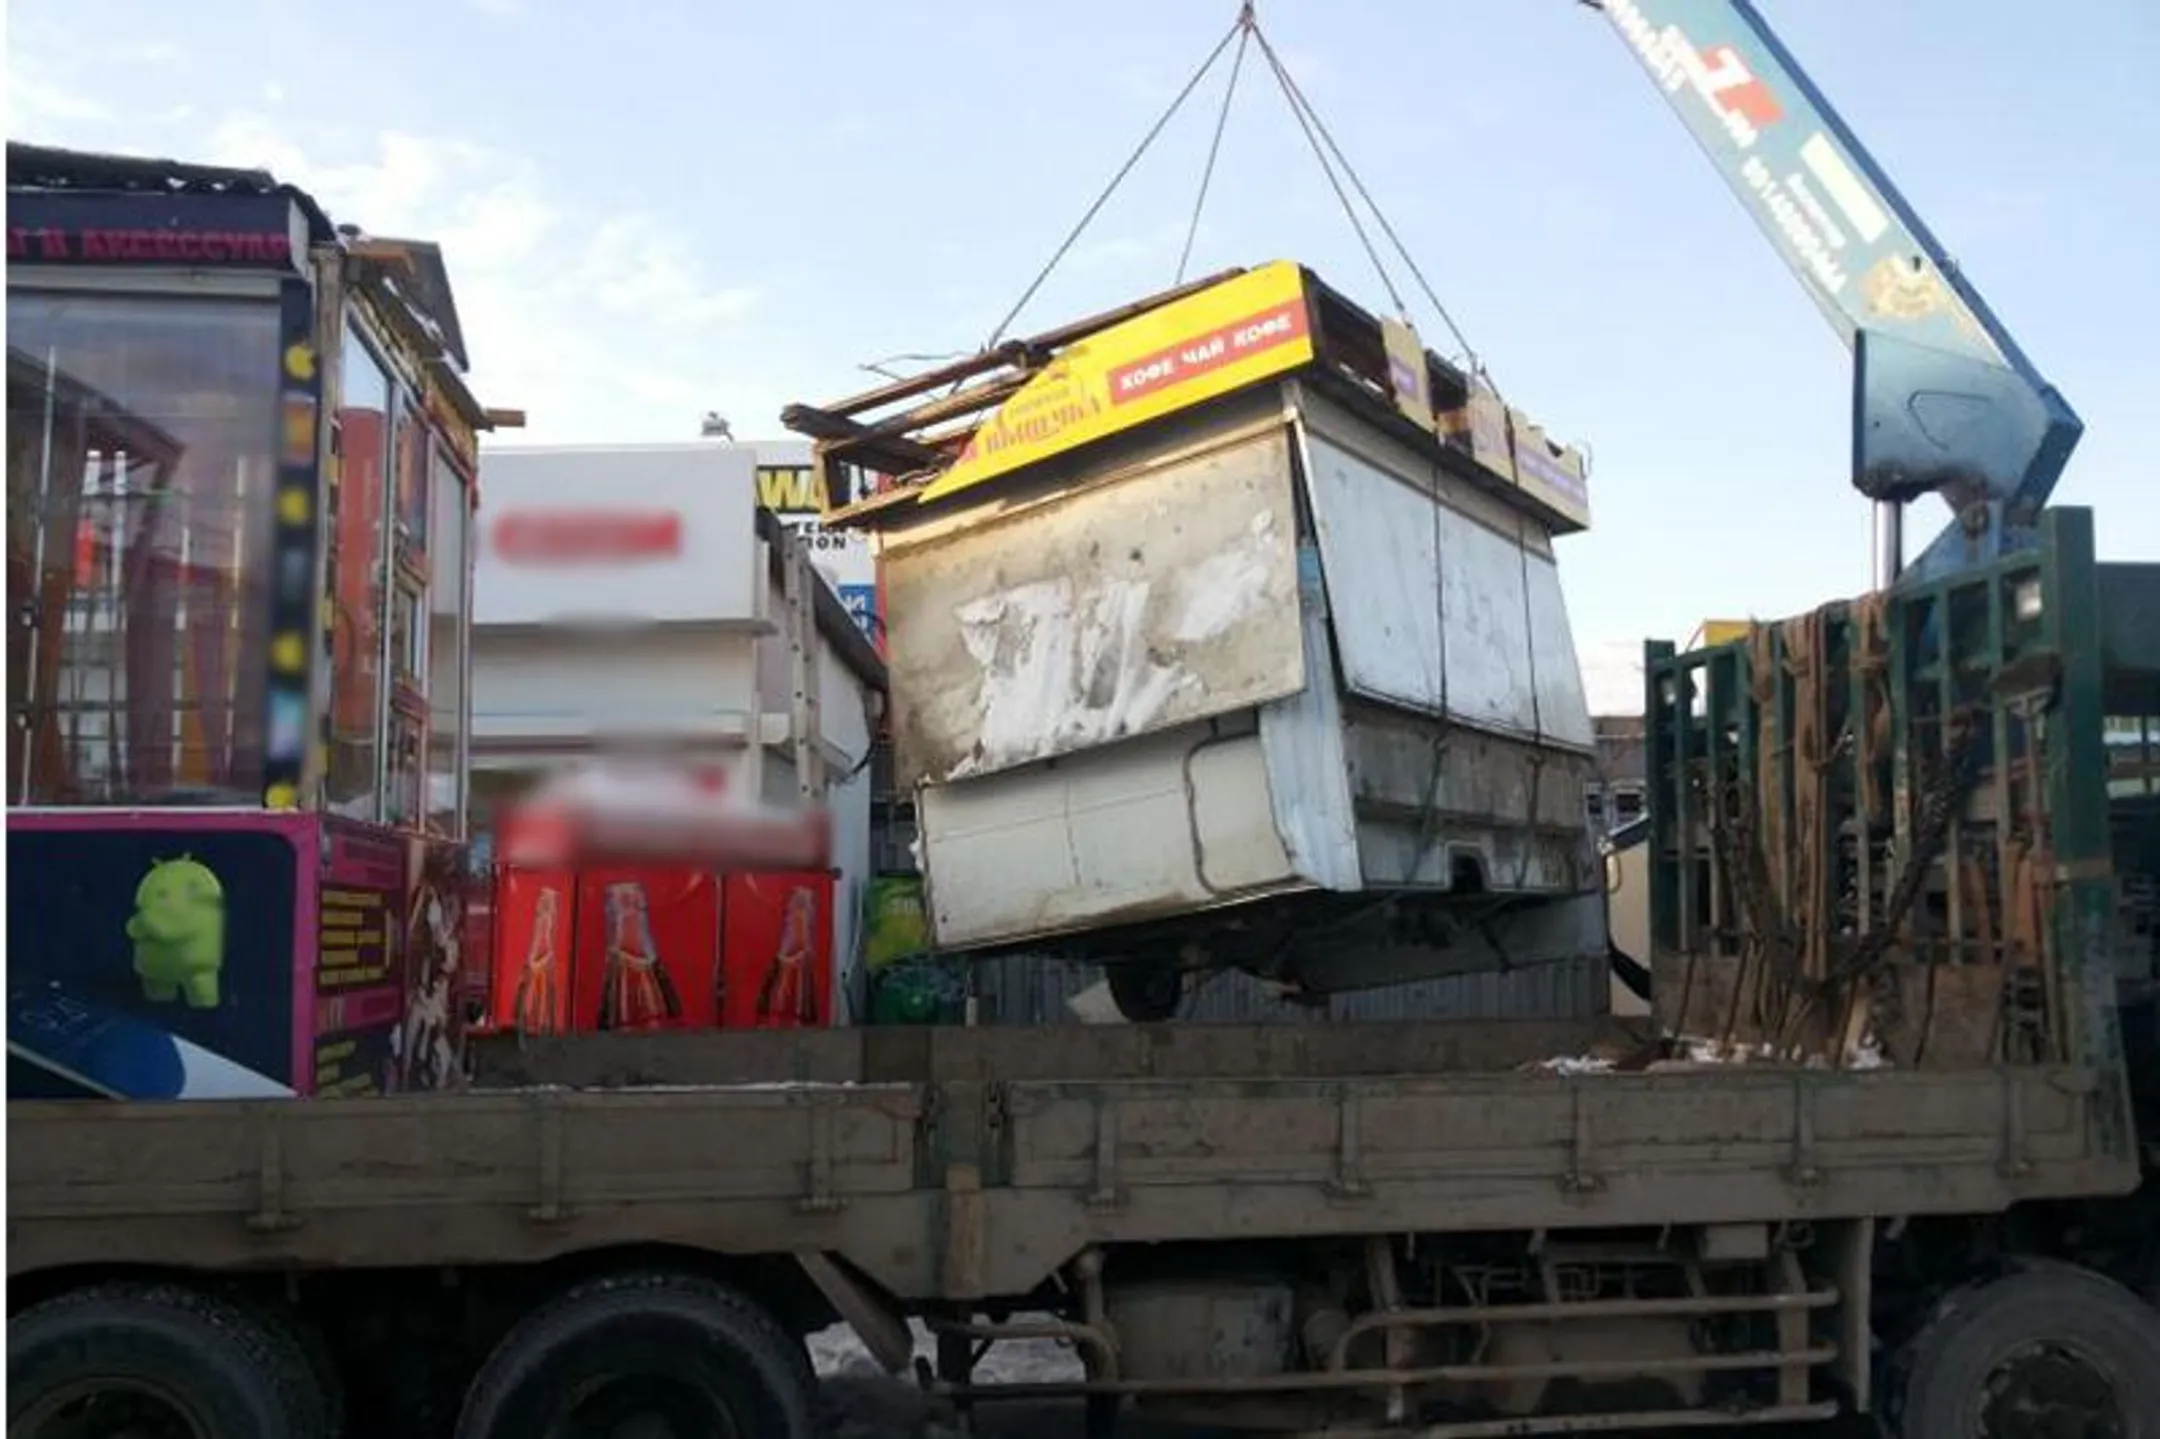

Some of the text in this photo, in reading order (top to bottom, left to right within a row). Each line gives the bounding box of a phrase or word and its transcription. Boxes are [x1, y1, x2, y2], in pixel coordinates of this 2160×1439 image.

[1121, 312, 1293, 390] КОФЕ ЧАЙ КОФЕ
